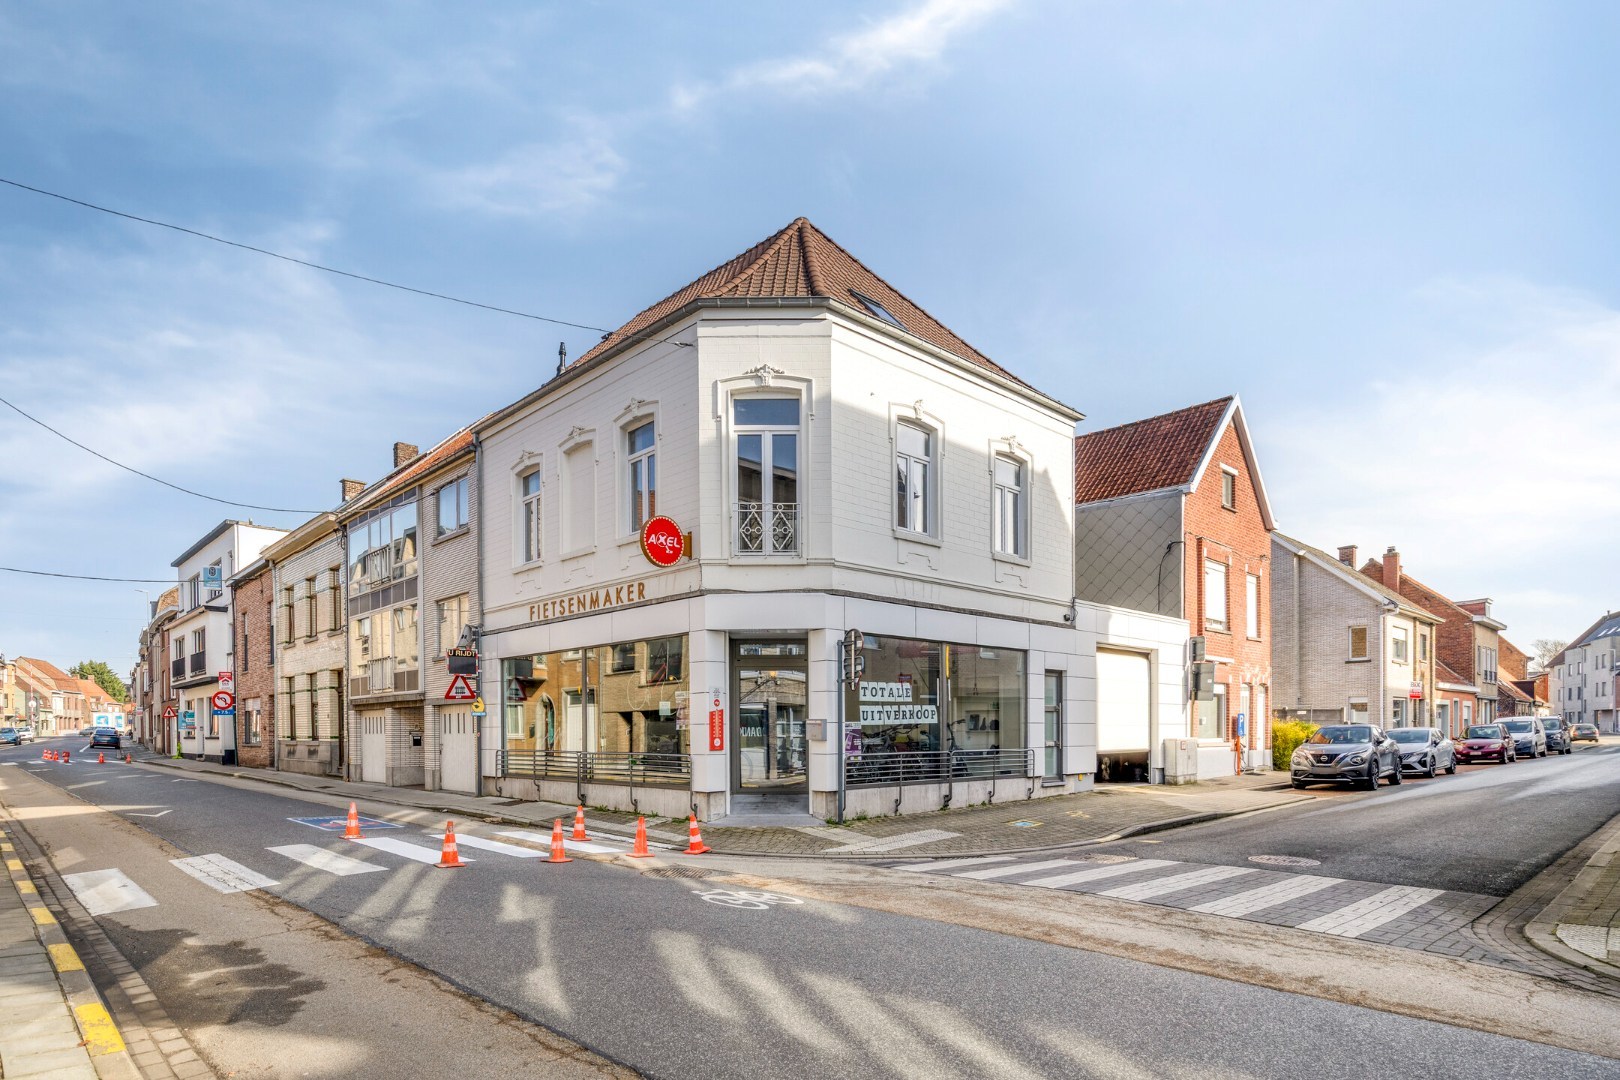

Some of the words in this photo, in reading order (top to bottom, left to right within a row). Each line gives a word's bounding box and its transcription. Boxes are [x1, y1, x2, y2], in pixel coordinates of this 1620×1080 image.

[648, 532, 680, 548] AXEL
[529, 582, 646, 621] FIETSENMAKER
[861, 686, 911, 697] TOTALE
[861, 709, 936, 721] UITVERKOOP
